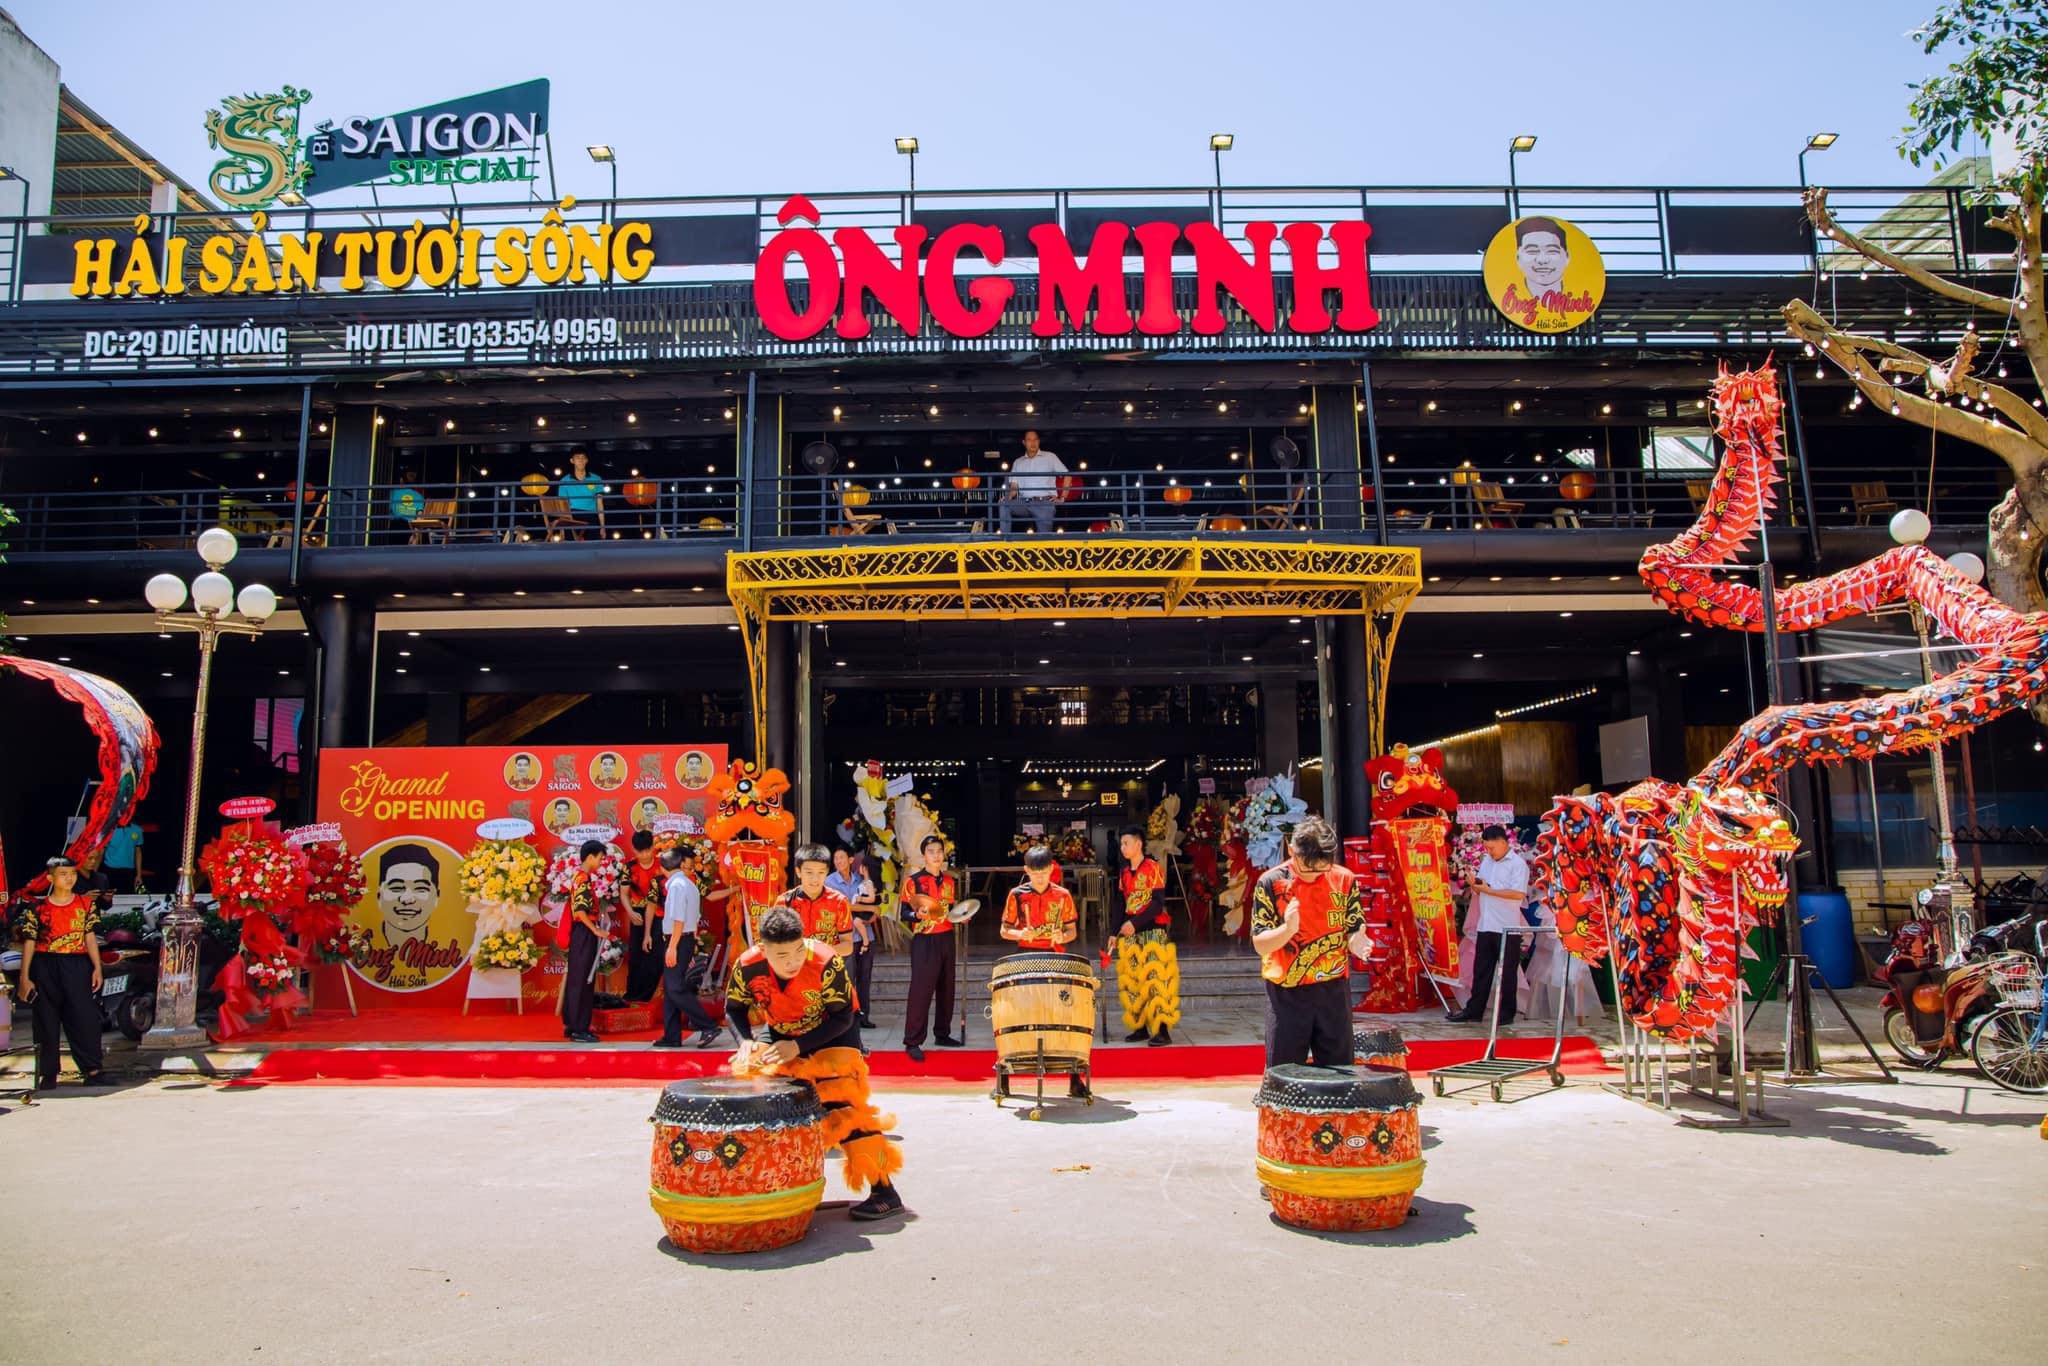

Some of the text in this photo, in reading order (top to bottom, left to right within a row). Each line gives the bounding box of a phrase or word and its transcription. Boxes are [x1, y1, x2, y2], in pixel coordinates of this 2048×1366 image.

[312, 119, 333, 157] BIA
[341, 112, 538, 154] SAIGON
[389, 156, 535, 186] SPECIAL
[70, 194, 655, 296] HẢI SẢN TƯƠI SỐNG
[753, 193, 1380, 341] ÔNG MINH
[1502, 283, 1595, 326] Ông Minh
[84, 318, 288, 357] ĐC:29 DIÊN HỒNG
[340, 760, 449, 817] Grand
[547, 783, 581, 791] SAIGON
[633, 782, 667, 791] SAIGON
[374, 799, 485, 820] OPENING
[399, 937, 462, 976] Minh
